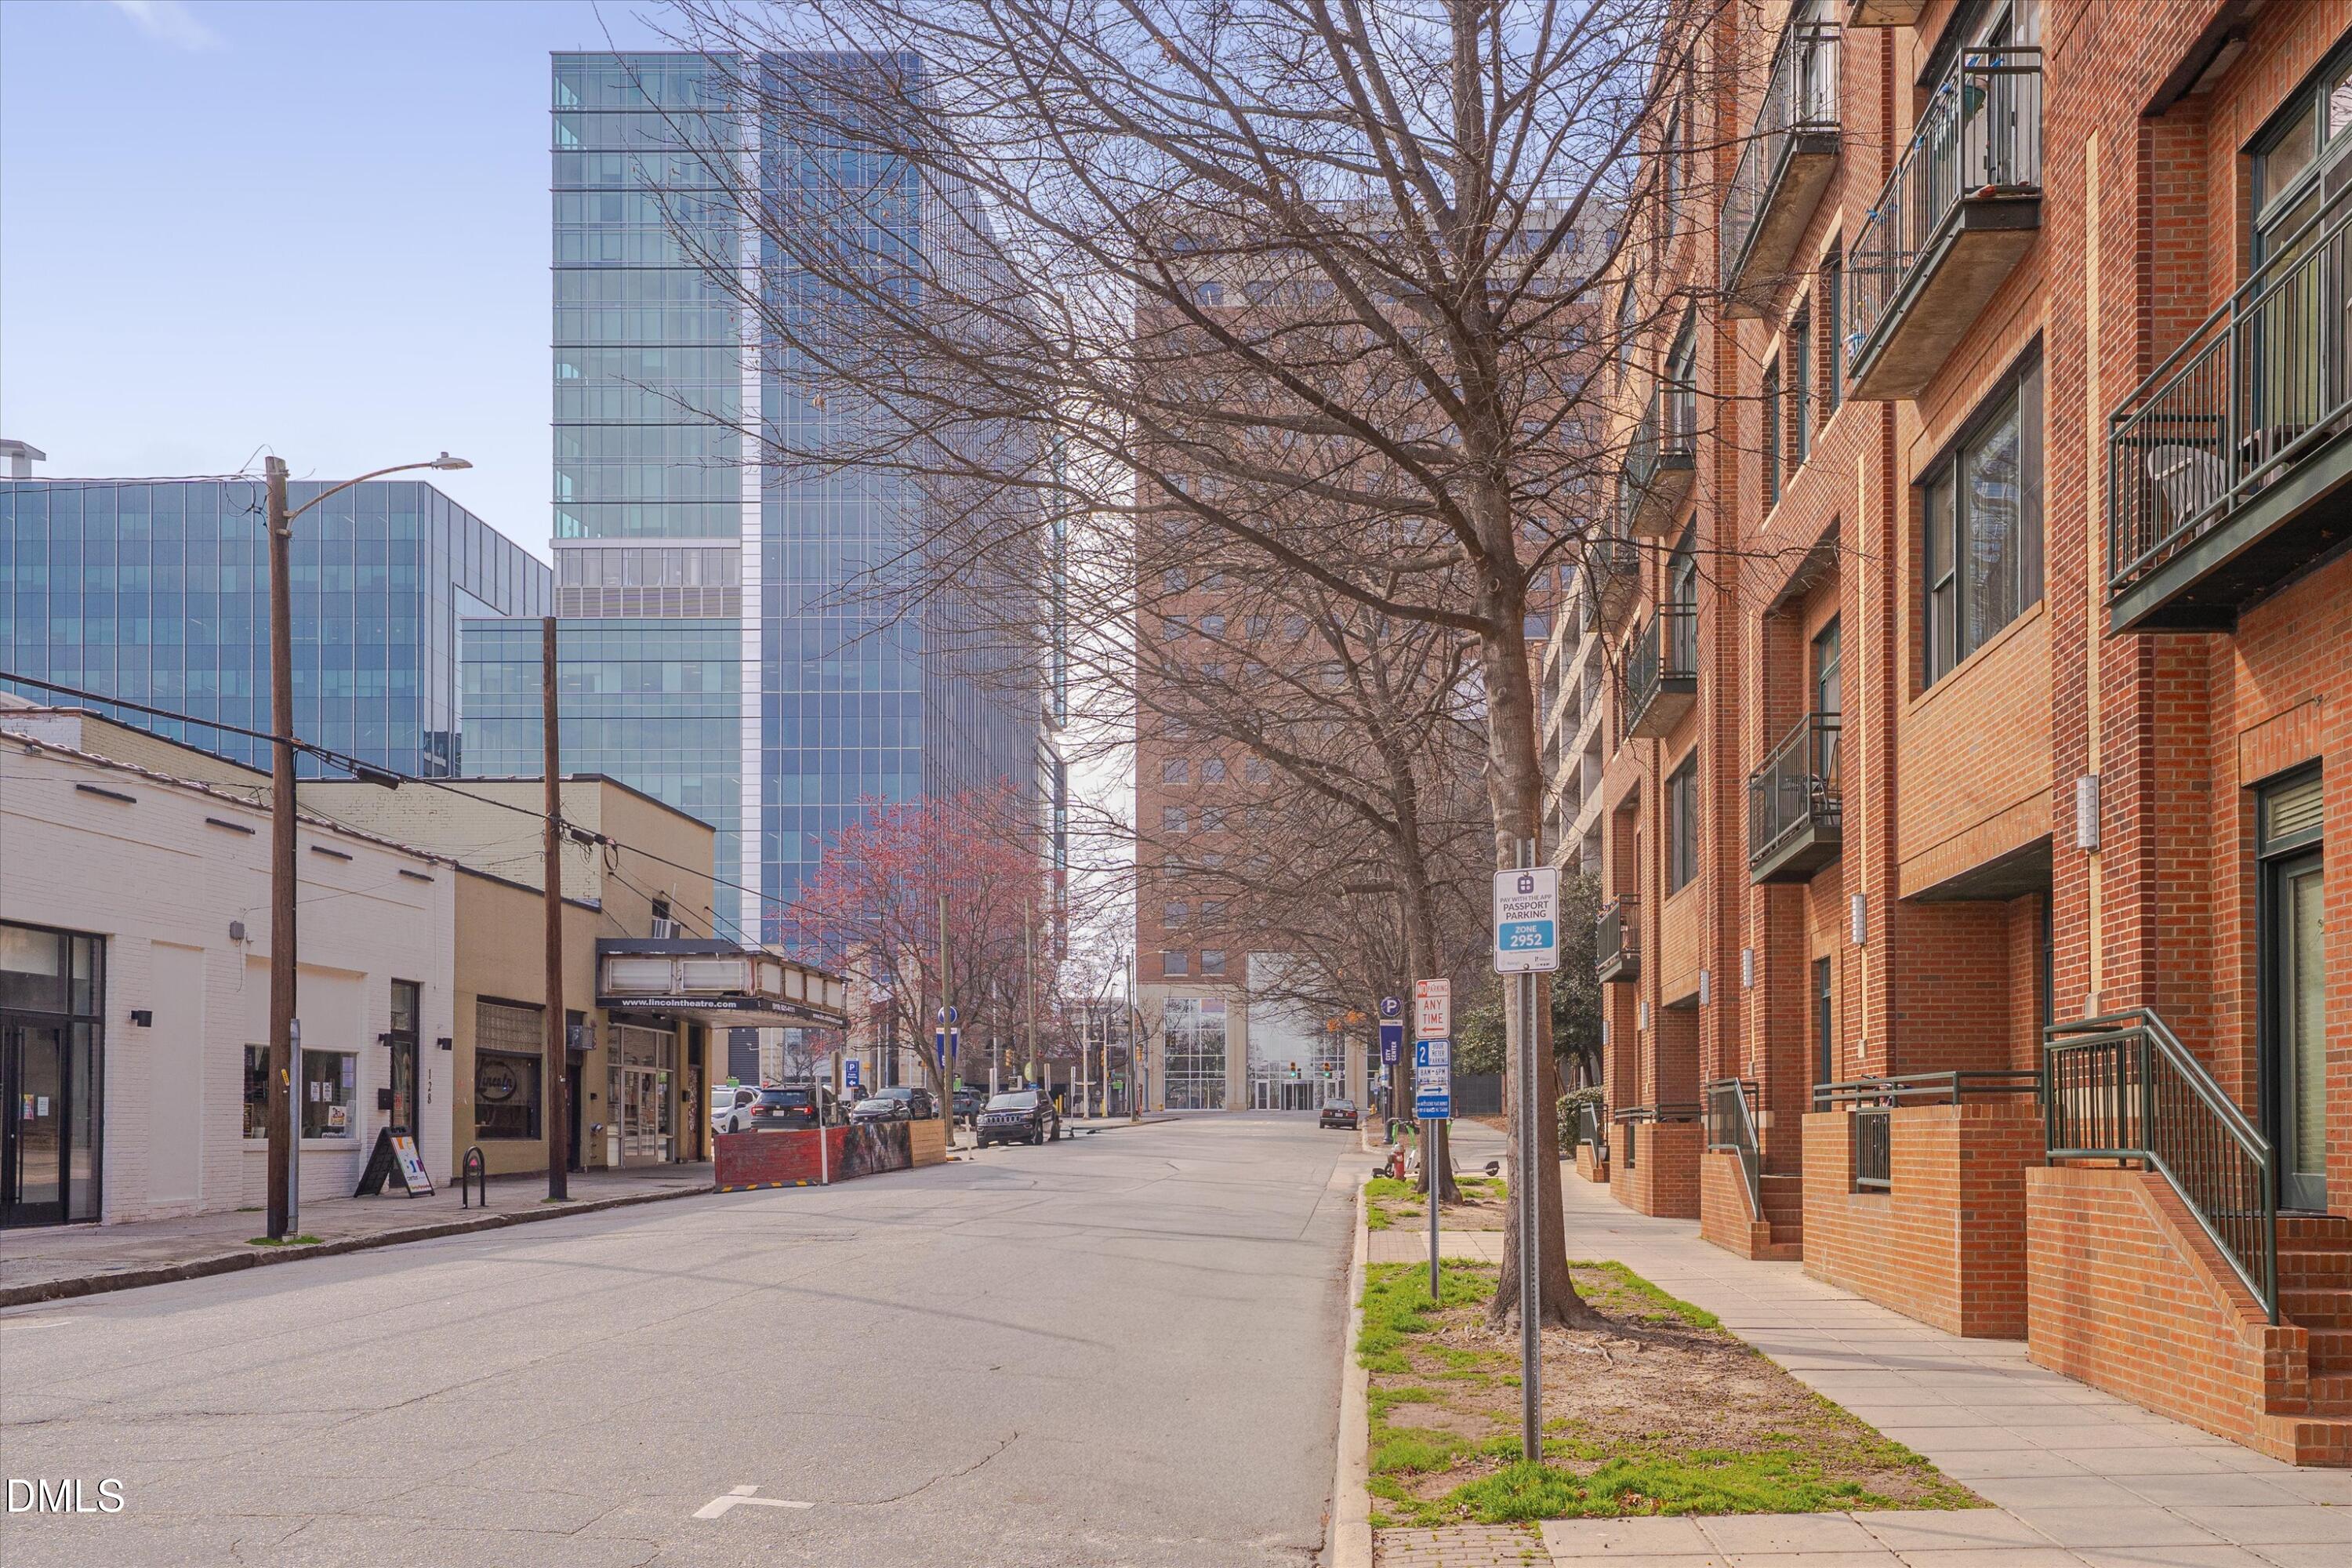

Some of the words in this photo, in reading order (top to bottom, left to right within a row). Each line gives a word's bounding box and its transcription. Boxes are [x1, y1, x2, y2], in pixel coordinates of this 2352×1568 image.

[1503, 901, 1549, 912] PASSPORT
[1506, 909, 1547, 920] PARKING
[1515, 925, 1537, 934] ZONE
[1510, 933, 1543, 947] 2952
[1417, 985, 1427, 995] NO
[1428, 984, 1448, 993] PARKING
[622, 998, 737, 1008] www.lincolntheatre.com
[1387, 1000, 1397, 1013] P
[1424, 999, 1442, 1011] ANY
[1423, 1013, 1443, 1024] TIME
[1420, 1046, 1426, 1063] 2
